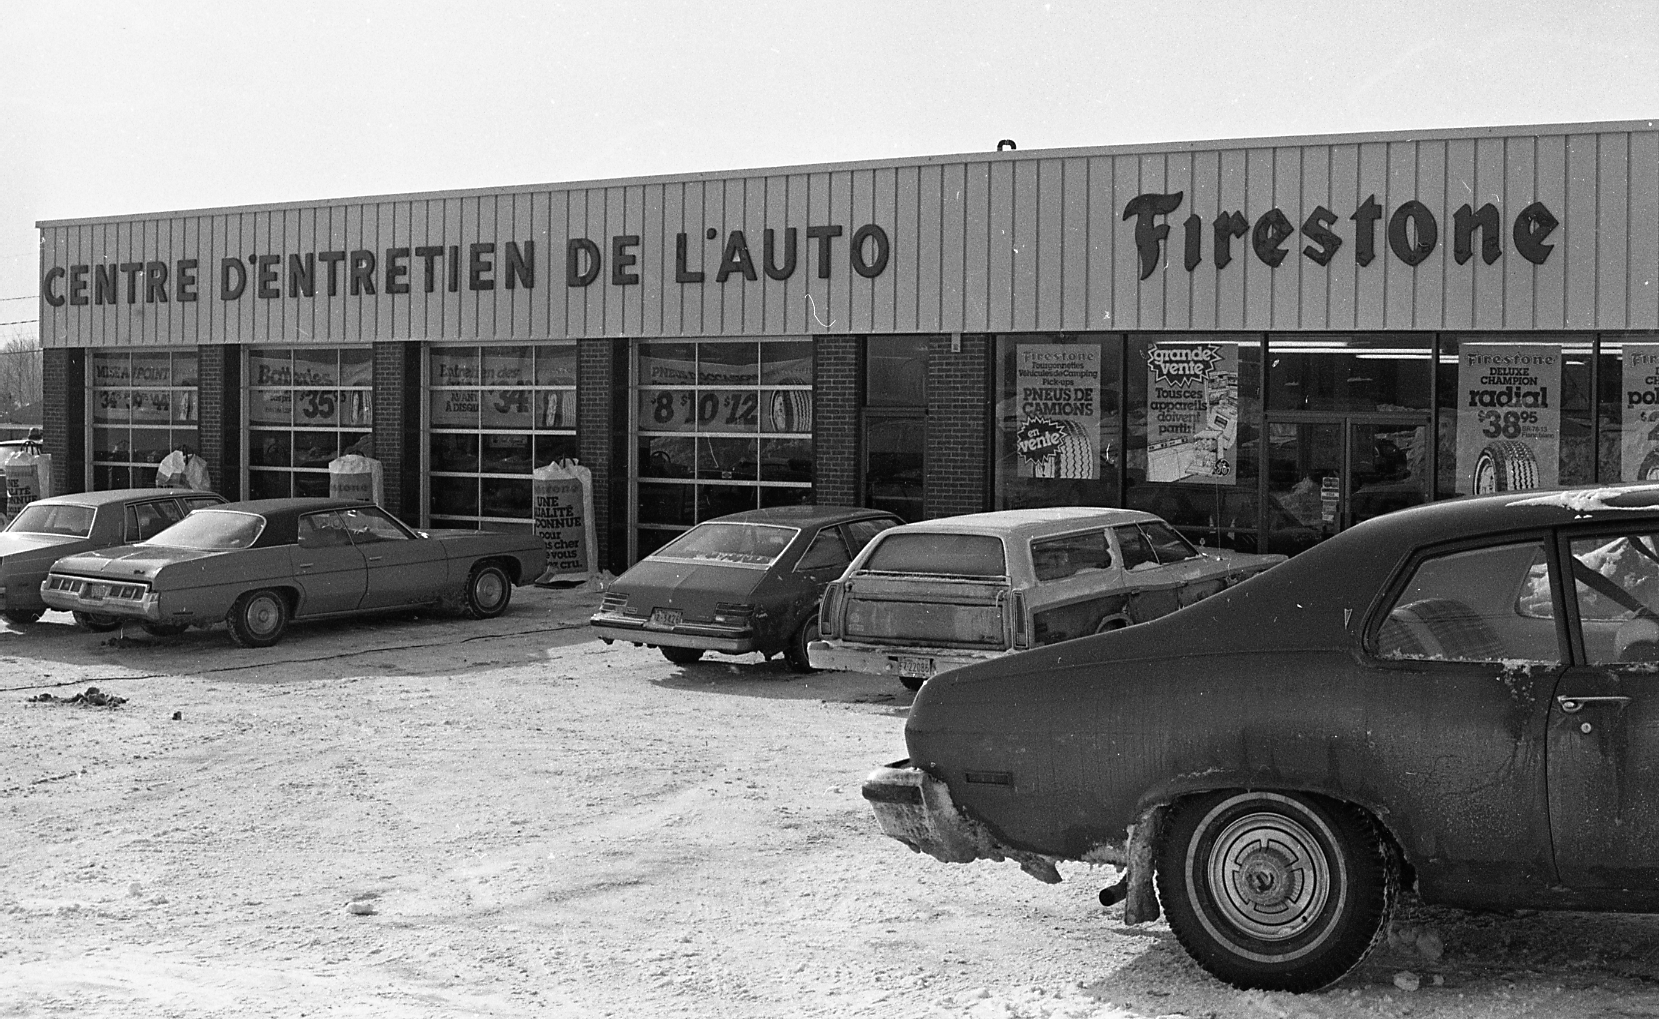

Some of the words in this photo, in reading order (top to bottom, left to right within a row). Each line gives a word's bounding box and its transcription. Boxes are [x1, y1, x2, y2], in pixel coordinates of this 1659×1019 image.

[1123, 191, 1559, 280] Firestone
[43, 259, 198, 306] CENTRE
[220, 242, 534, 301] D'ENTRETIEN
[567, 235, 639, 287] DE
[676, 224, 889, 283] L'AUTO
[1022, 351, 1094, 362] Firestone
[1153, 346, 1211, 364] grande
[1467, 353, 1554, 366] Firestone
[1160, 361, 1204, 374] vente
[1490, 367, 1529, 376] DELUXE
[1480, 376, 1538, 385] CHAMPION
[1023, 388, 1071, 401] PNEUS
[1074, 388, 1093, 401] DE
[1155, 388, 1182, 399] Tous
[1183, 389, 1203, 399] ces
[1469, 386, 1548, 408] radial
[1022, 402, 1094, 416] CAMIONS
[1150, 400, 1208, 412] appareils
[1157, 412, 1200, 423] doivent
[1028, 428, 1040, 438] en
[1019, 431, 1060, 452] vente
[536, 496, 559, 507] UNE
[554, 539, 580, 549] cher
[551, 550, 578, 559] vous
